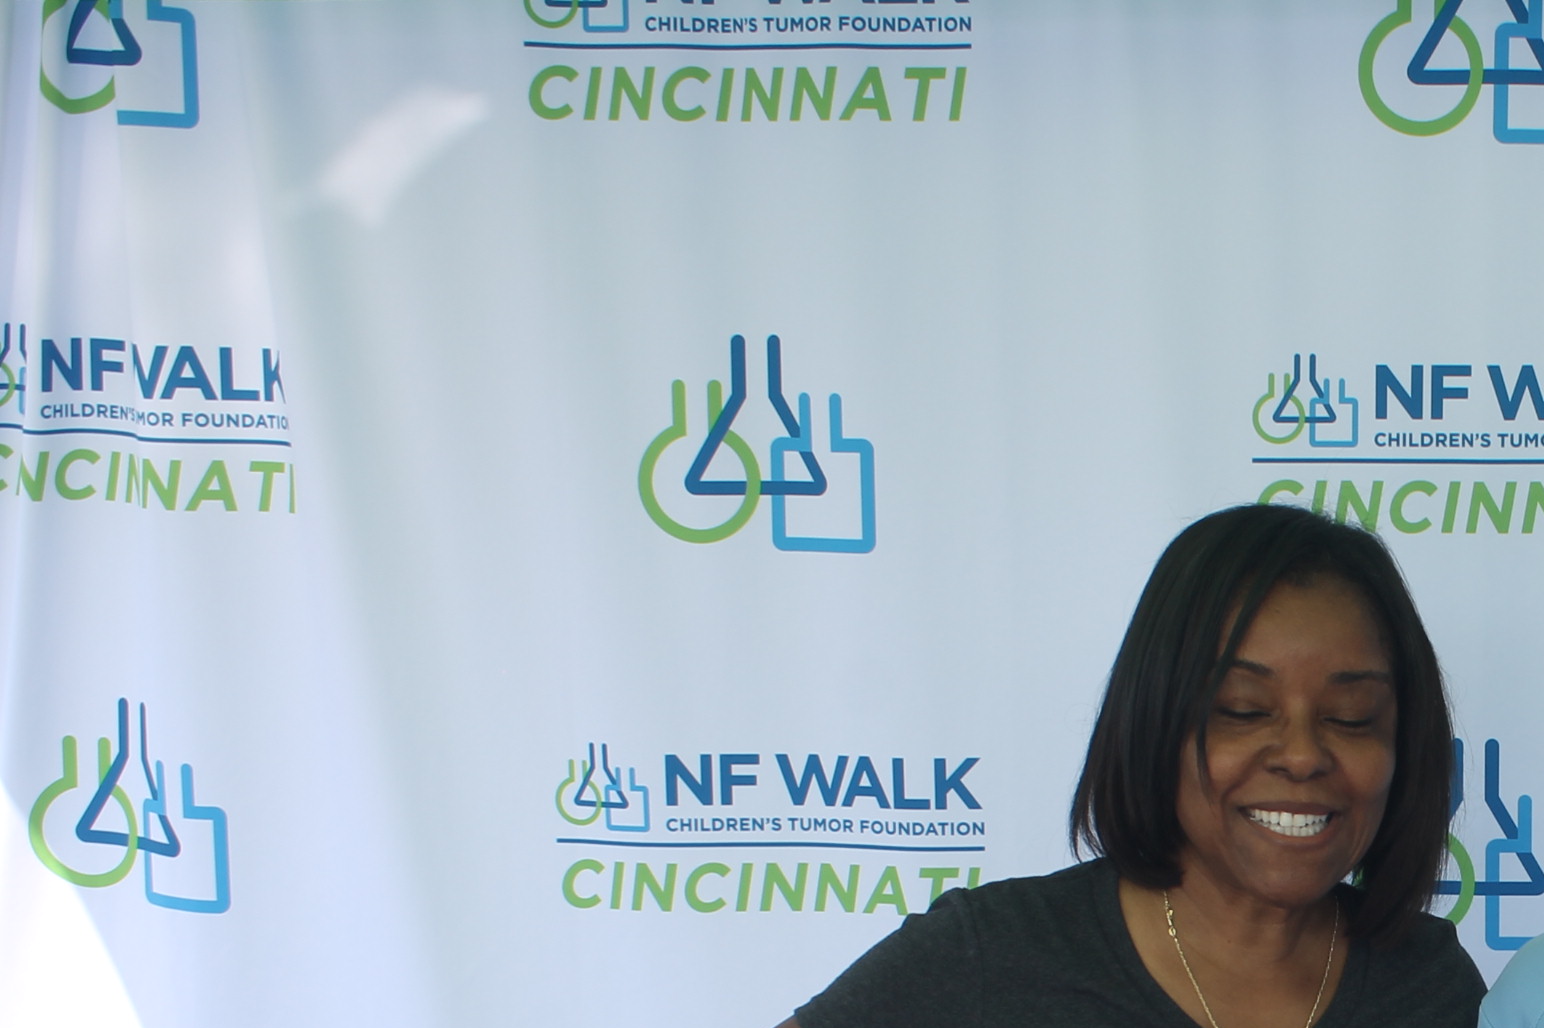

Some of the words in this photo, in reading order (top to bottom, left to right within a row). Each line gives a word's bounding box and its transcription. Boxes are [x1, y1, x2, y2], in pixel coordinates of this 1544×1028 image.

[645, 16, 758, 33] CHILDREN'S
[765, 16, 832, 33] TUMOR
[838, 16, 972, 33] FOUNDATION
[528, 64, 968, 122] CINCINNATI
[41, 337, 126, 393] NF
[1374, 364, 1473, 420] NF
[136, 412, 174, 428] MOR
[181, 413, 290, 430] FOUNDATIO
[1374, 432, 1491, 449] CHILDREN'S
[0, 443, 296, 514] NCINNATI
[664, 753, 760, 807] NF
[775, 753, 983, 811] WALK
[666, 817, 782, 833] CHILDREN'S
[788, 817, 854, 834] TUMOR
[860, 820, 986, 837] FOUNDATION
